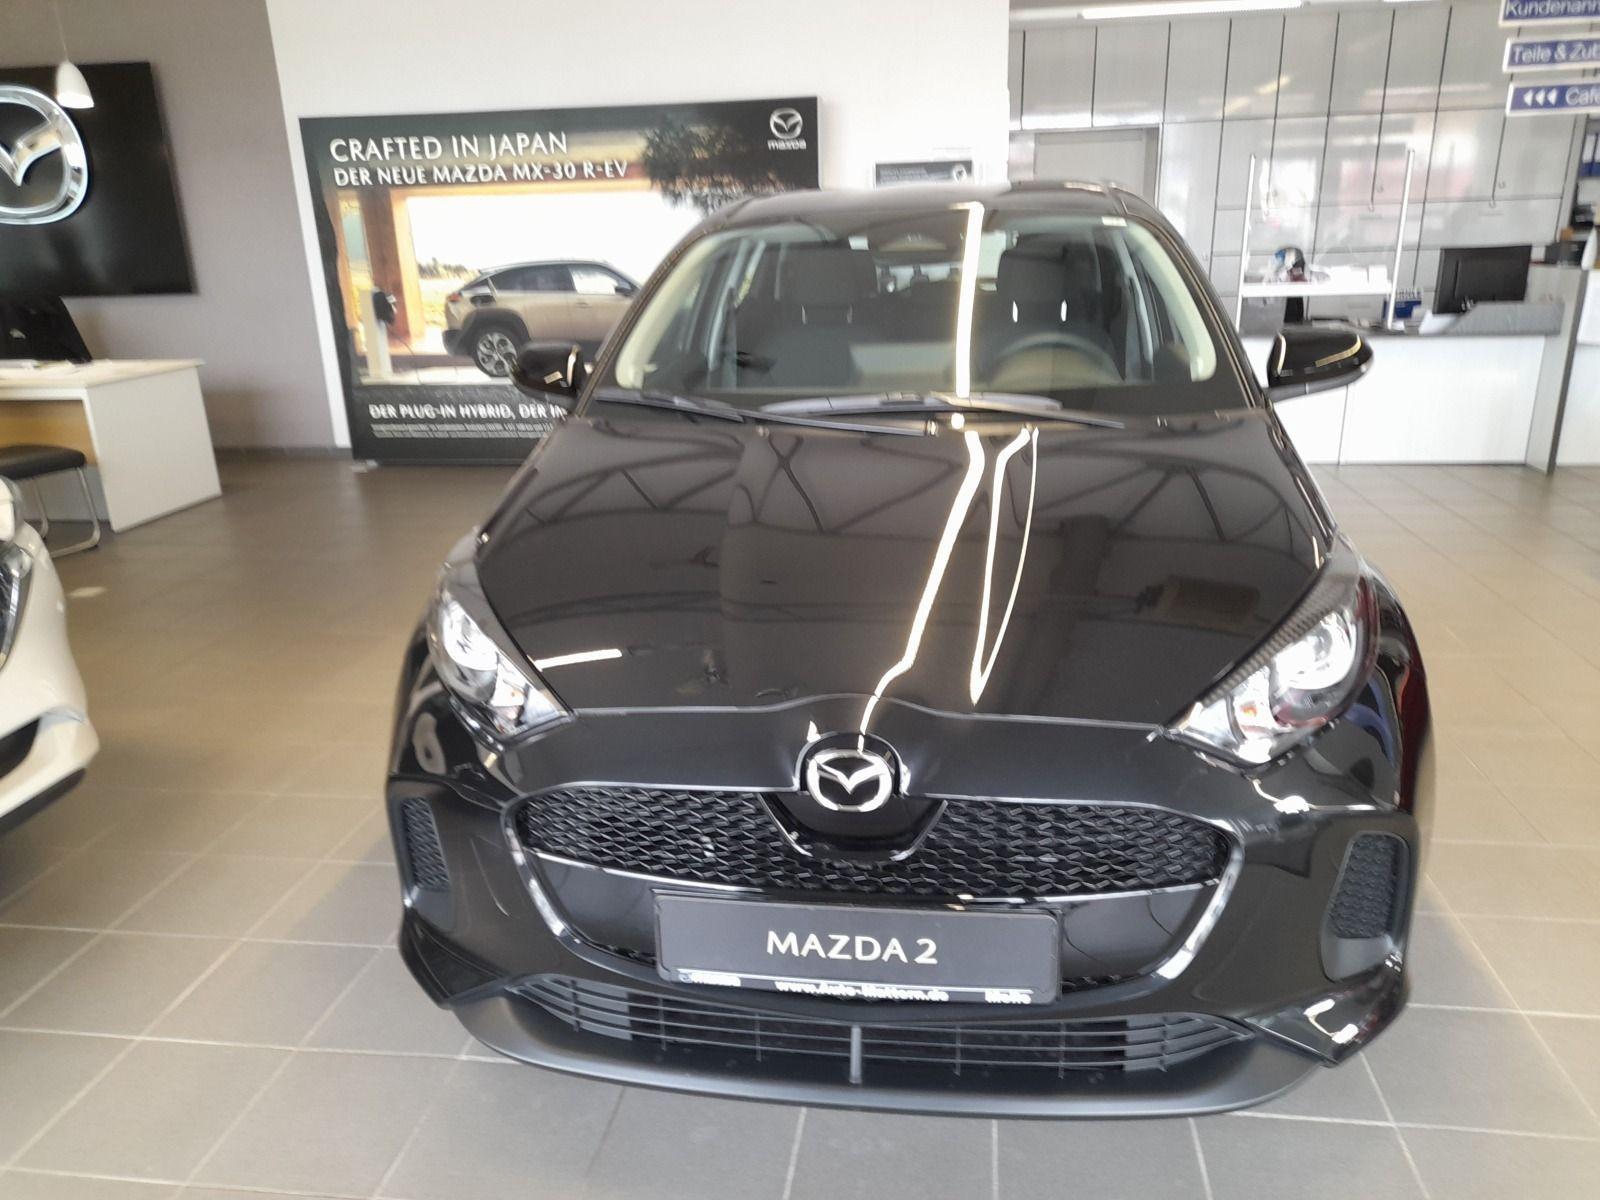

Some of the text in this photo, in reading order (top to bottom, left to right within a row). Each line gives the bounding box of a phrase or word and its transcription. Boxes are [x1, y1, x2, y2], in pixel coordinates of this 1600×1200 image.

[1513, 45, 1552, 63] Teile
[1554, 43, 1566, 61] &
[329, 131, 568, 162] CRAFTED IN JAPAN
[334, 159, 628, 187] DER NEUE MAZDA MX-30 R-EV
[369, 404, 398, 419] DER
[399, 404, 456, 419] PLUG-IN
[459, 404, 516, 420] HYBRID,
[518, 404, 548, 419] DER
[766, 930, 939, 966] MAZDA 2
